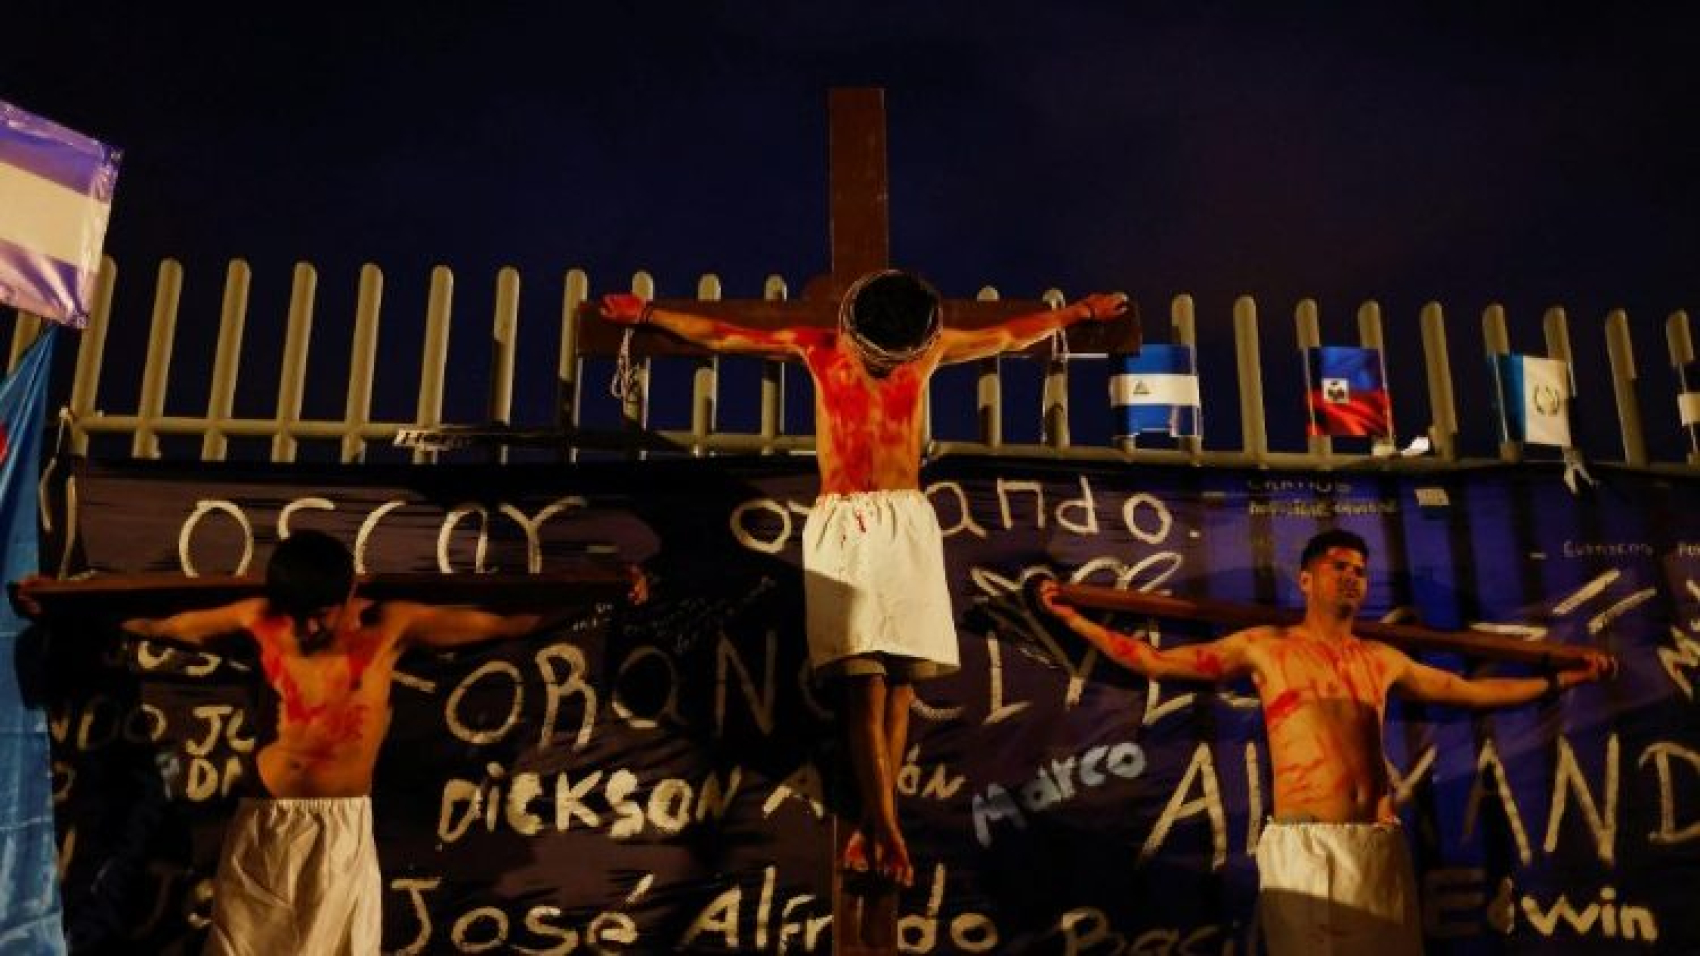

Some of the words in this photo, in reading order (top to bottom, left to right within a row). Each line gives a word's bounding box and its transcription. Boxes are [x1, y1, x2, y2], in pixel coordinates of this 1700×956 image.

[972, 741, 1146, 848] Marco
[391, 873, 654, 956] José
[683, 862, 1000, 956] Alfrdo
[1421, 868, 1658, 941] Edwin
